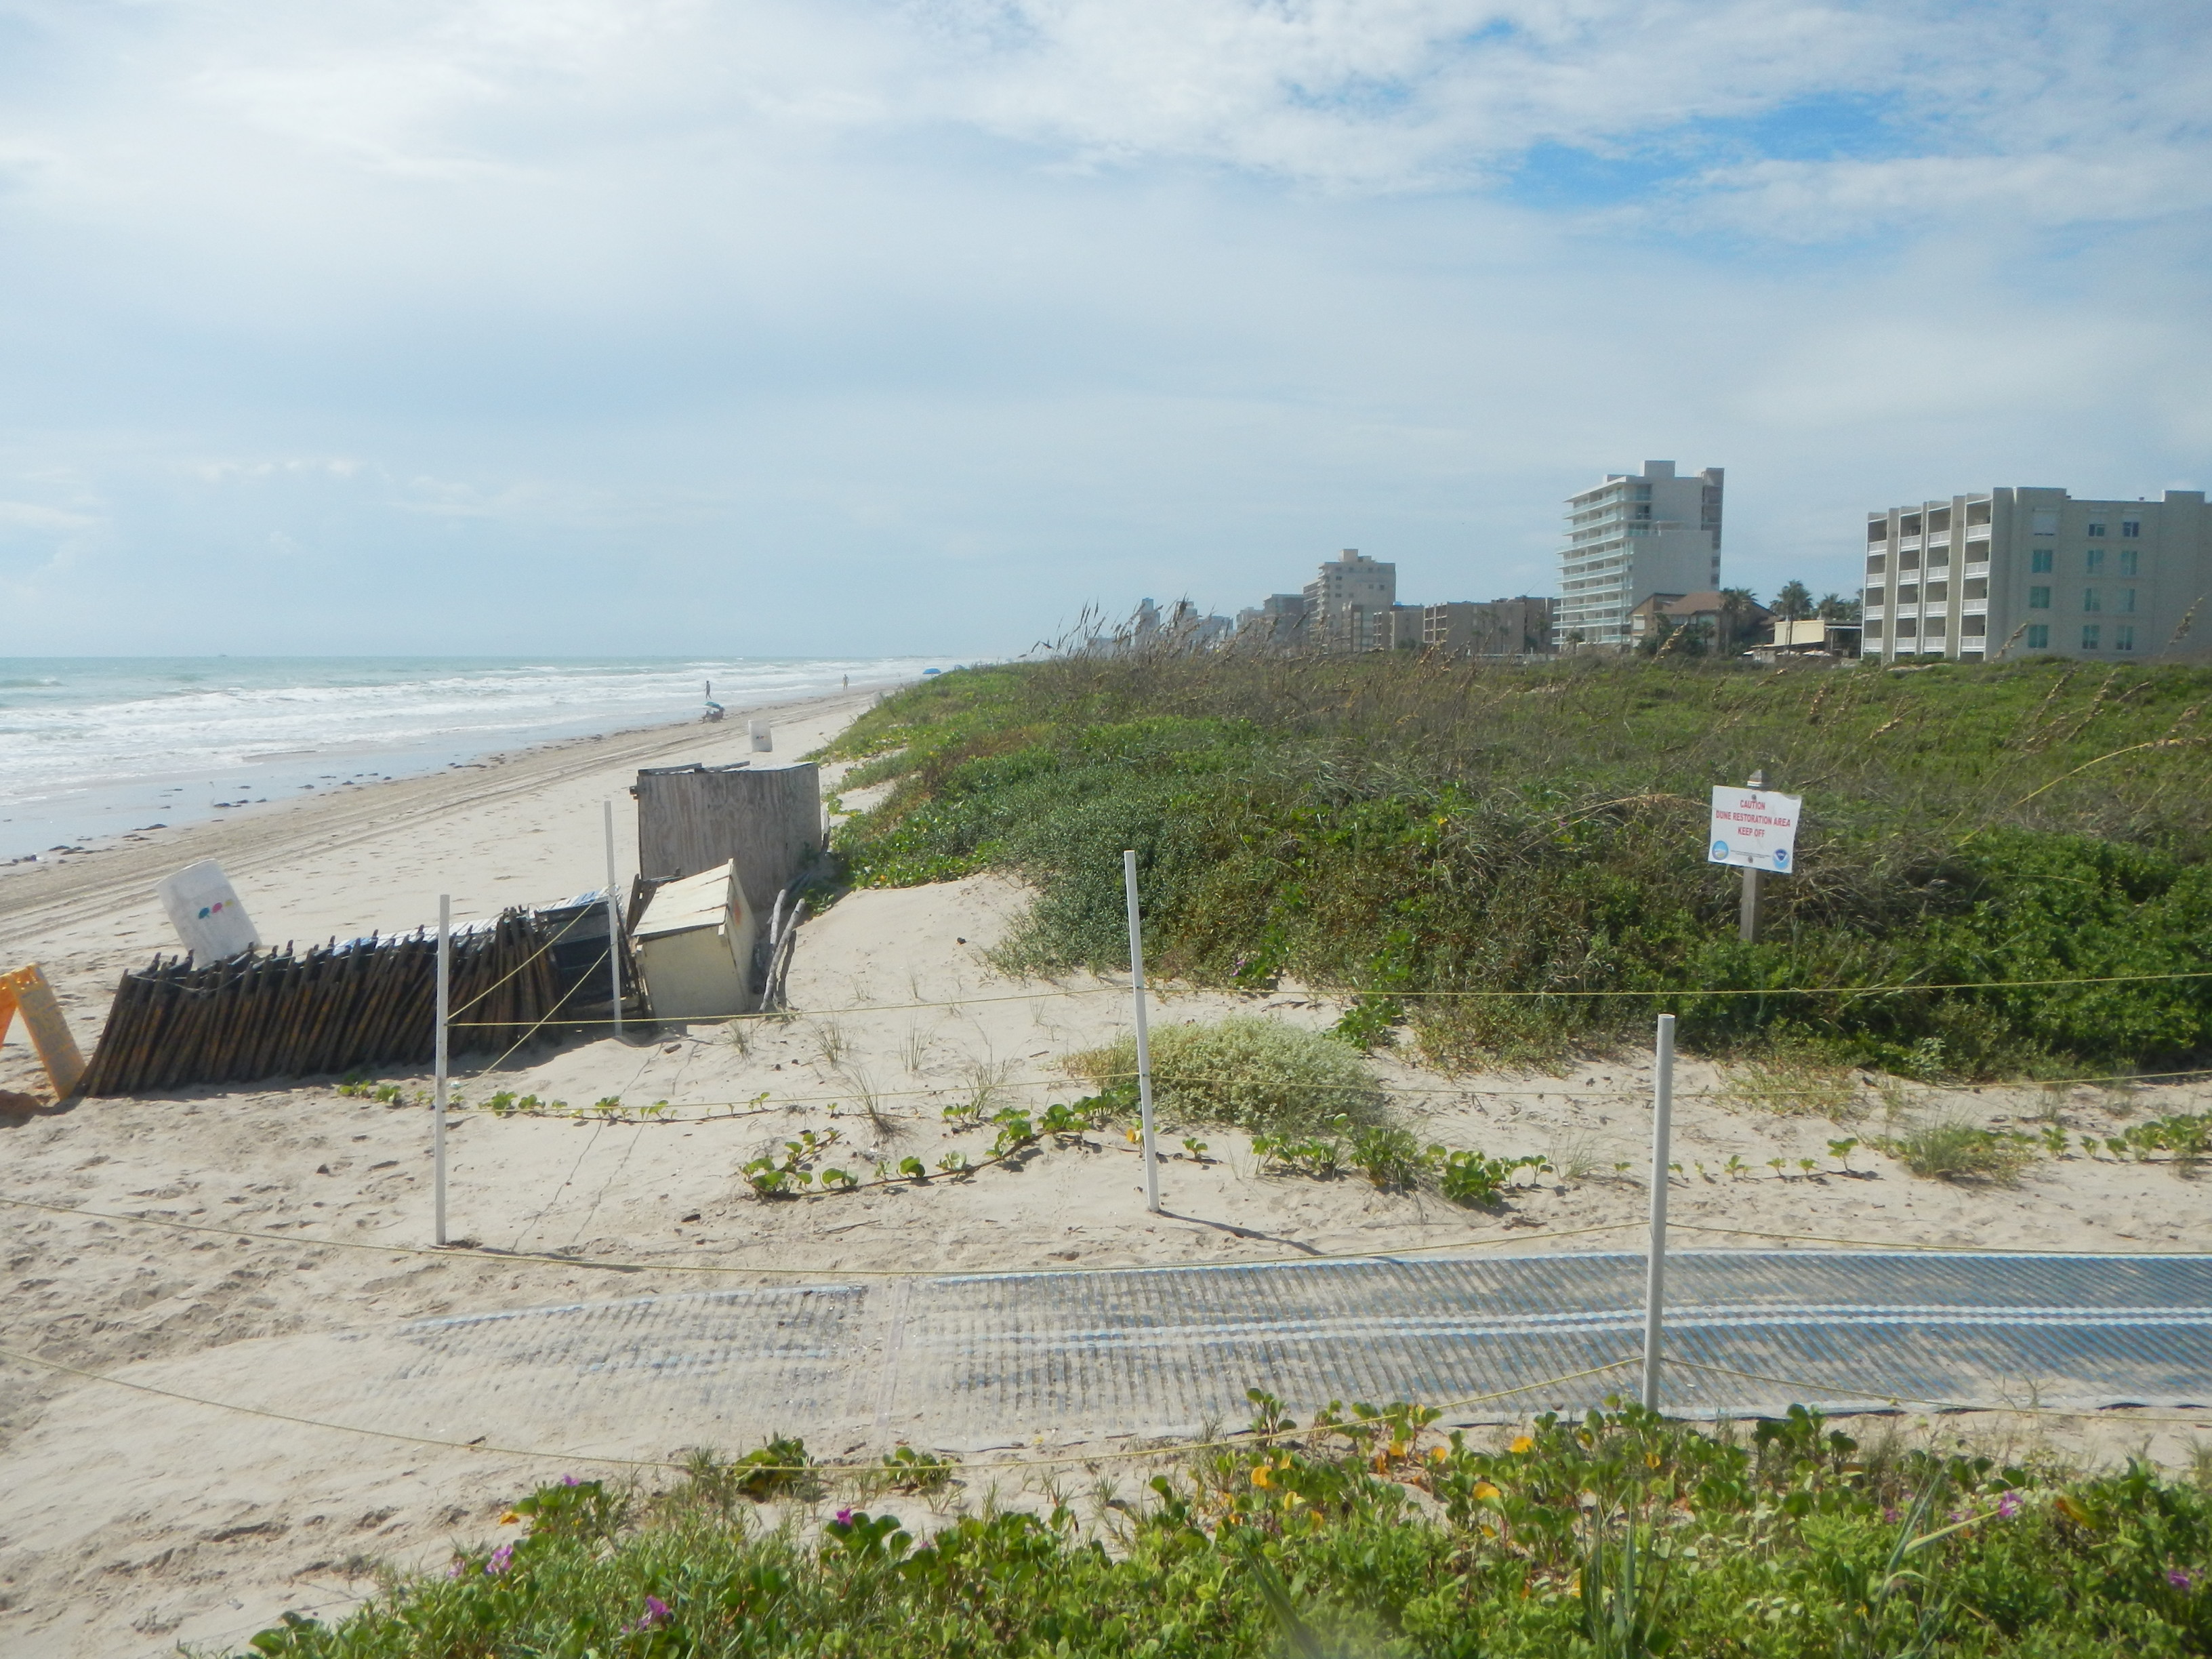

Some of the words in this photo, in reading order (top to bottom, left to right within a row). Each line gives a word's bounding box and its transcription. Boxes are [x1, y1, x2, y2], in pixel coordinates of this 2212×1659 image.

[1740, 800, 1765, 810] CAUTION
[1716, 811, 1731, 819] DUNE
[1733, 813, 1771, 825] RESTORATION
[1774, 817, 1790, 827] AREA
[1738, 827, 1753, 836] KEEP
[1754, 829, 1765, 837] OFF
